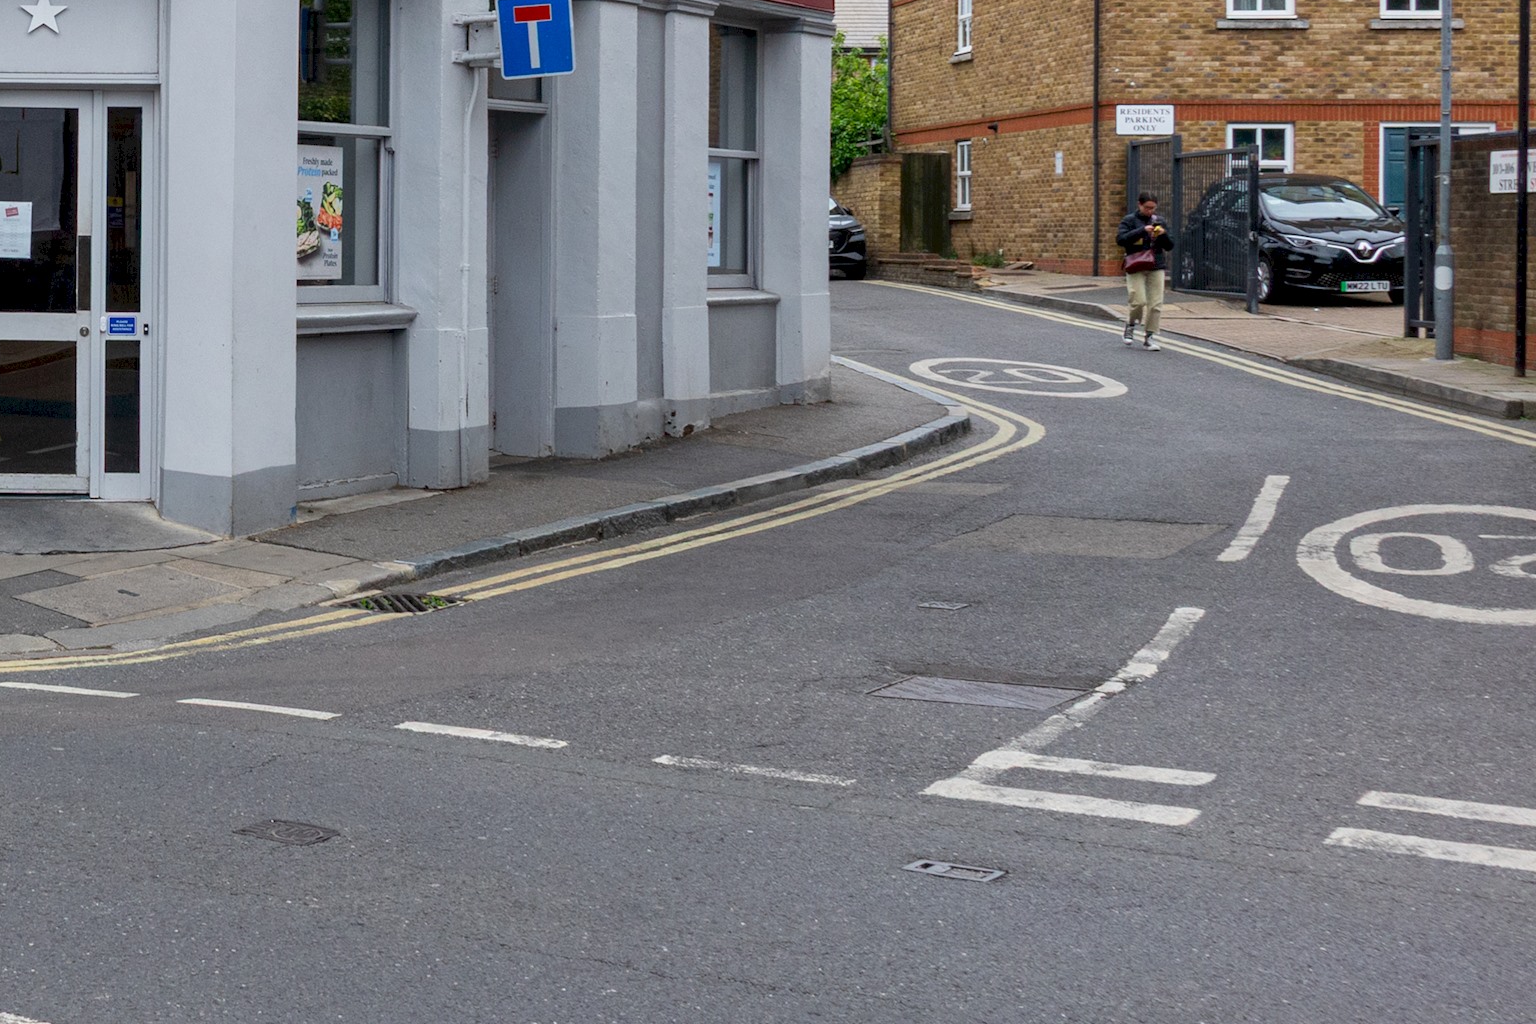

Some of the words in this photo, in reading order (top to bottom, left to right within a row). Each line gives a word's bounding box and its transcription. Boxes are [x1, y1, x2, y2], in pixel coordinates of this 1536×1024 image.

[302, 156, 319, 168] Freshly
[320, 157, 333, 166] made
[297, 166, 321, 177] Protein
[322, 168, 338, 178] packed
[1370, 282, 1388, 290] LTU
[937, 368, 1086, 384] 20
